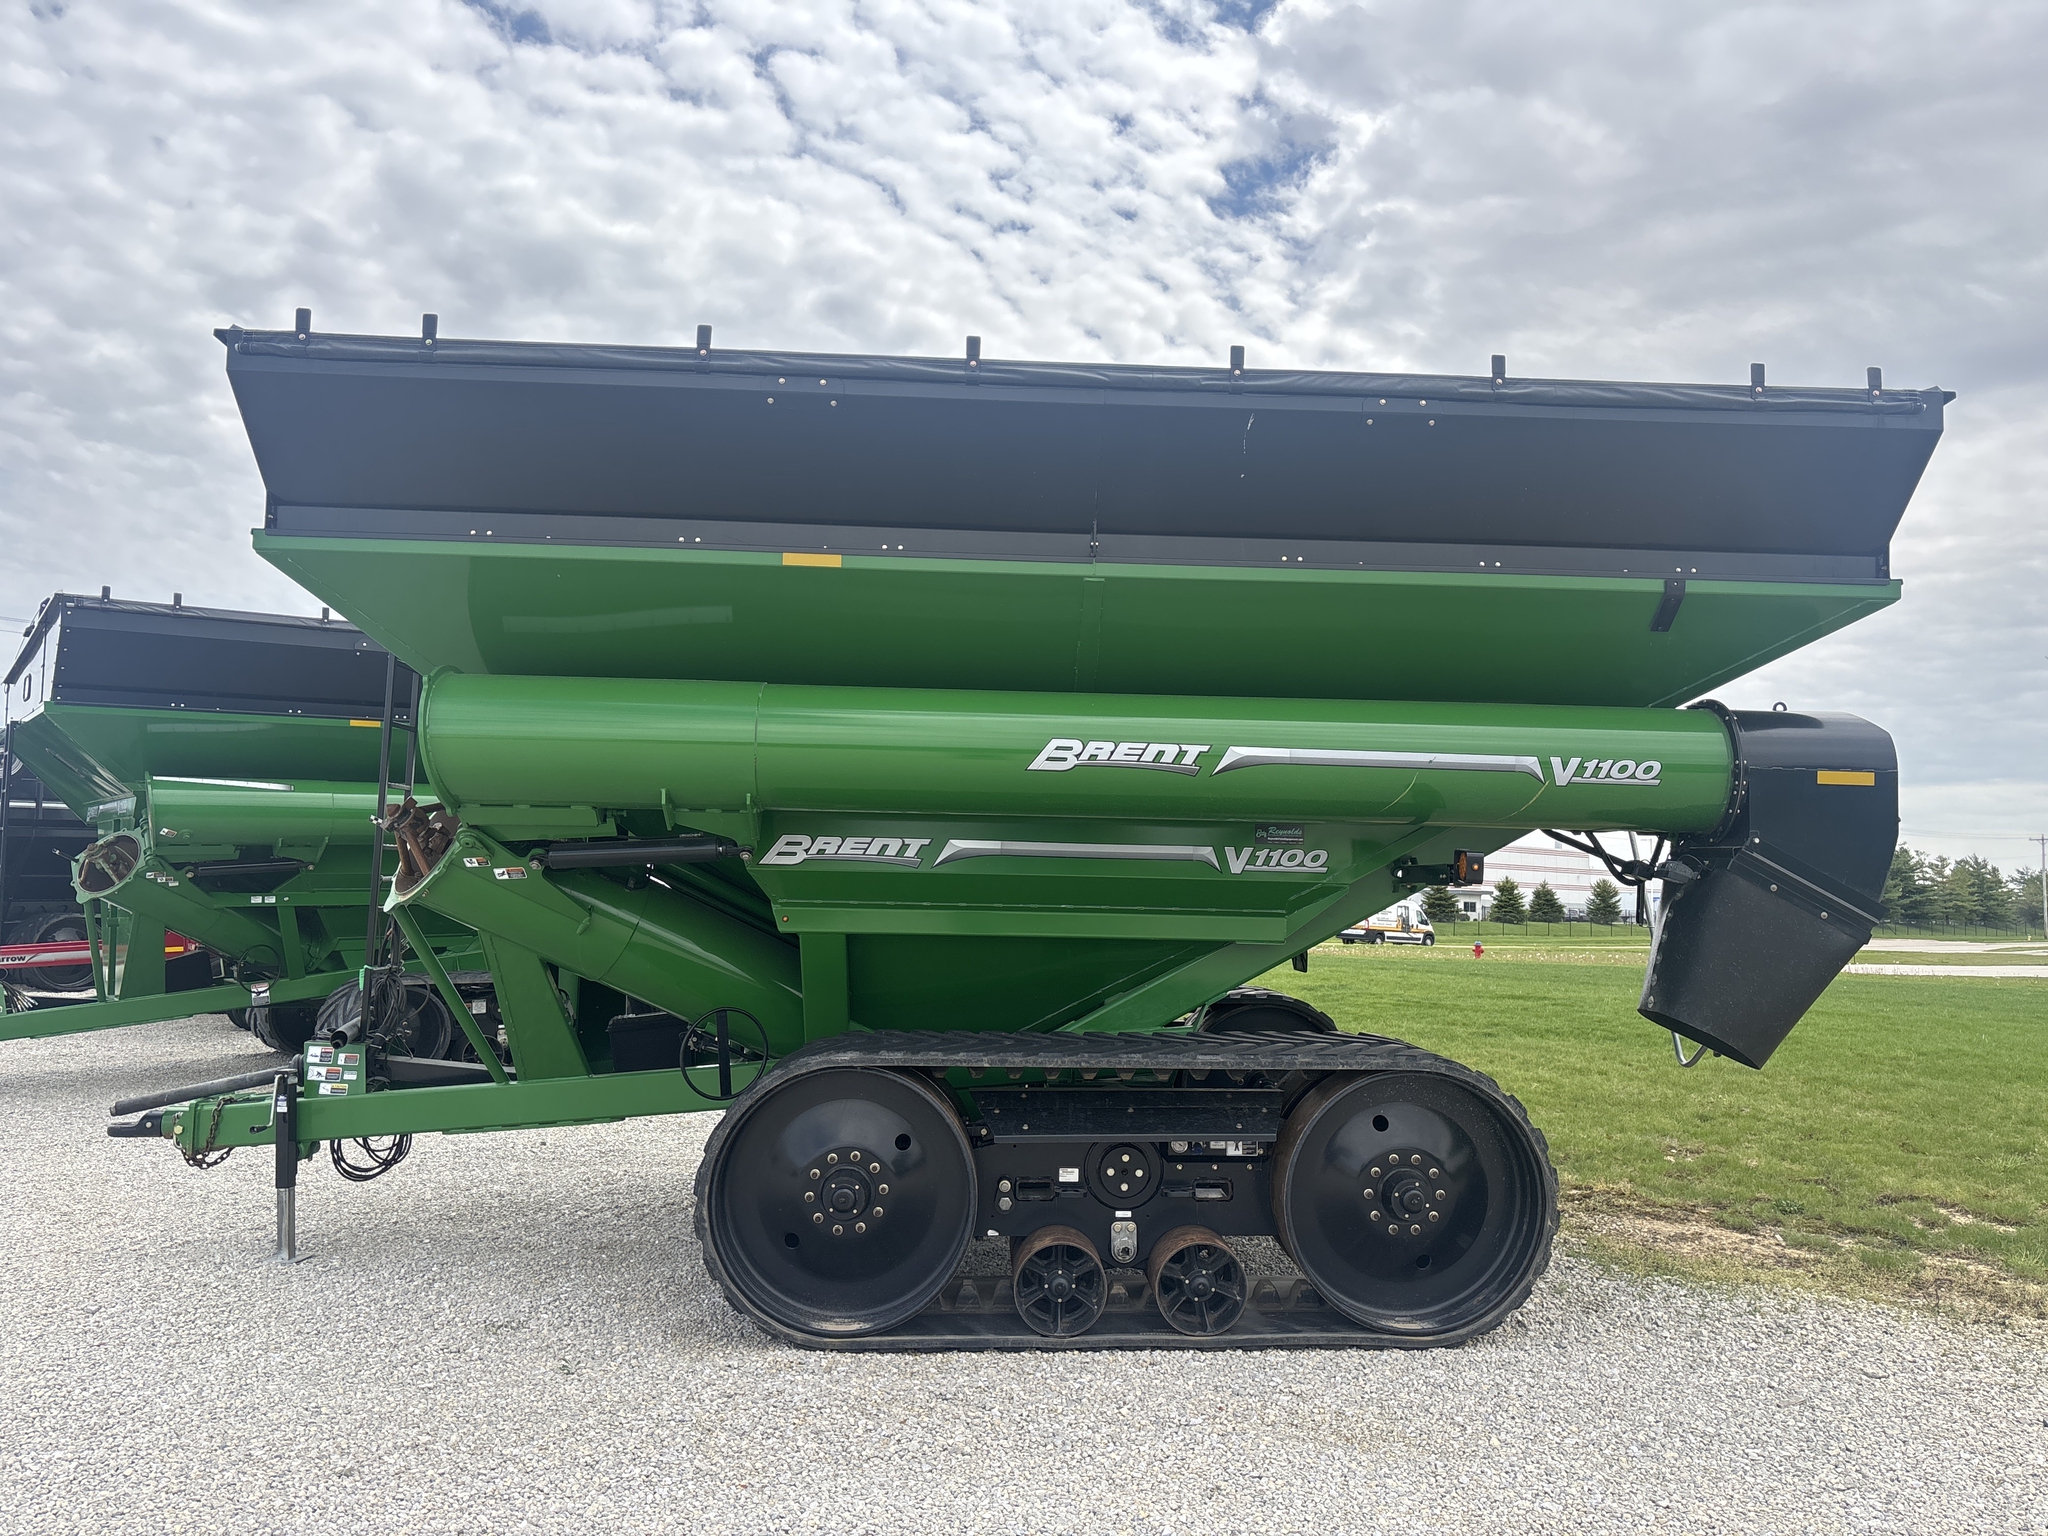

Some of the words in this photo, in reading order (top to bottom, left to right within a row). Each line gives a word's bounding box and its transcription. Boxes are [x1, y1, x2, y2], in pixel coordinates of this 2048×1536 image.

[1026, 738, 1212, 776] BRENT
[1549, 756, 1662, 786] V1100
[1268, 826, 1302, 835] Reynolds
[757, 834, 933, 868] BRENT
[1224, 846, 1329, 874] V1100
[0, 955, 26, 963] rrow
